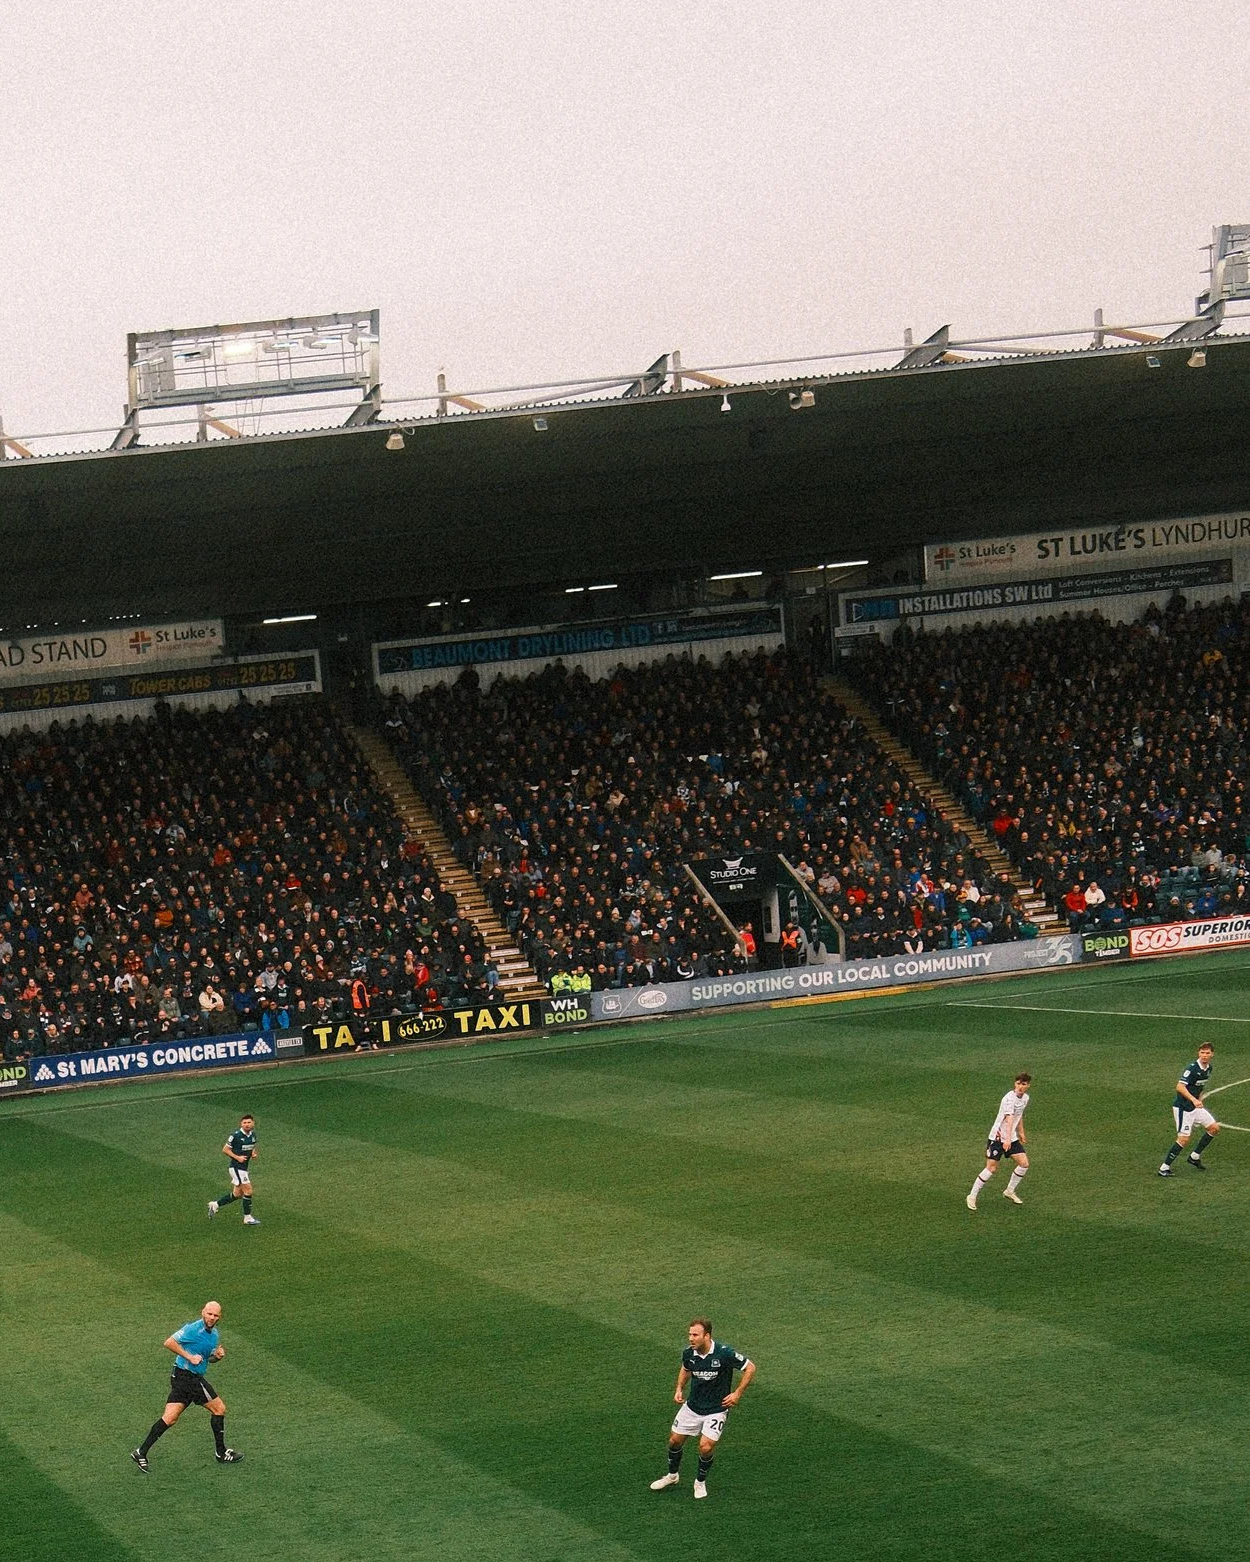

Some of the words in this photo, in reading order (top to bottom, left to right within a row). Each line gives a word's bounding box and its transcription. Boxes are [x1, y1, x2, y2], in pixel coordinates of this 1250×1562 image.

[959, 547, 971, 558] St
[976, 543, 1016, 557] Luke's
[1037, 537, 1063, 559] ST
[1069, 529, 1146, 555] LUKE'S
[1058, 580, 1073, 588] Loft
[1075, 574, 1122, 587] Conversions
[1129, 570, 1161, 581] Kitchens
[1169, 565, 1210, 576] Extensions
[1059, 588, 1091, 598] Summer
[1154, 578, 1185, 588] Porches
[899, 588, 1002, 614] INSTALLATIONS
[1004, 586, 1029, 602] SW
[1031, 583, 1053, 599] Ltd
[156, 630, 170, 643] St
[174, 626, 216, 641] Luke's
[411, 641, 510, 668] BEAUMONT
[517, 629, 615, 657] DRYLINING
[621, 622, 649, 646] LTD
[31, 637, 107, 664] STAND
[129, 677, 175, 695] TOWER
[178, 675, 212, 692] CABS
[239, 667, 256, 684] 25
[260, 665, 276, 681] 25
[279, 662, 296, 679] 25
[33, 687, 50, 706] 25
[53, 684, 70, 705] 25
[72, 682, 90, 702] 25
[710, 869, 738, 879] STUDIO
[739, 867, 757, 876] ONE
[1135, 926, 1183, 951] SOS
[1183, 920, 1250, 937] SUPERIOR
[692, 973, 794, 1001] SUPPORTING
[799, 971, 834, 988] OUR
[837, 964, 891, 984] LOCAL
[893, 952, 992, 978] COMMUNITY
[544, 1008, 588, 1025] BOND
[550, 998, 579, 1012] WH
[313, 1020, 392, 1050] TAI
[399, 1017, 445, 1038] 666-222
[454, 1004, 531, 1034] TAXI
[57, 1062, 77, 1077] St
[80, 1052, 149, 1075] MARY'S
[152, 1040, 250, 1065] CONCRETE
[710, 1419, 724, 1431] 20
